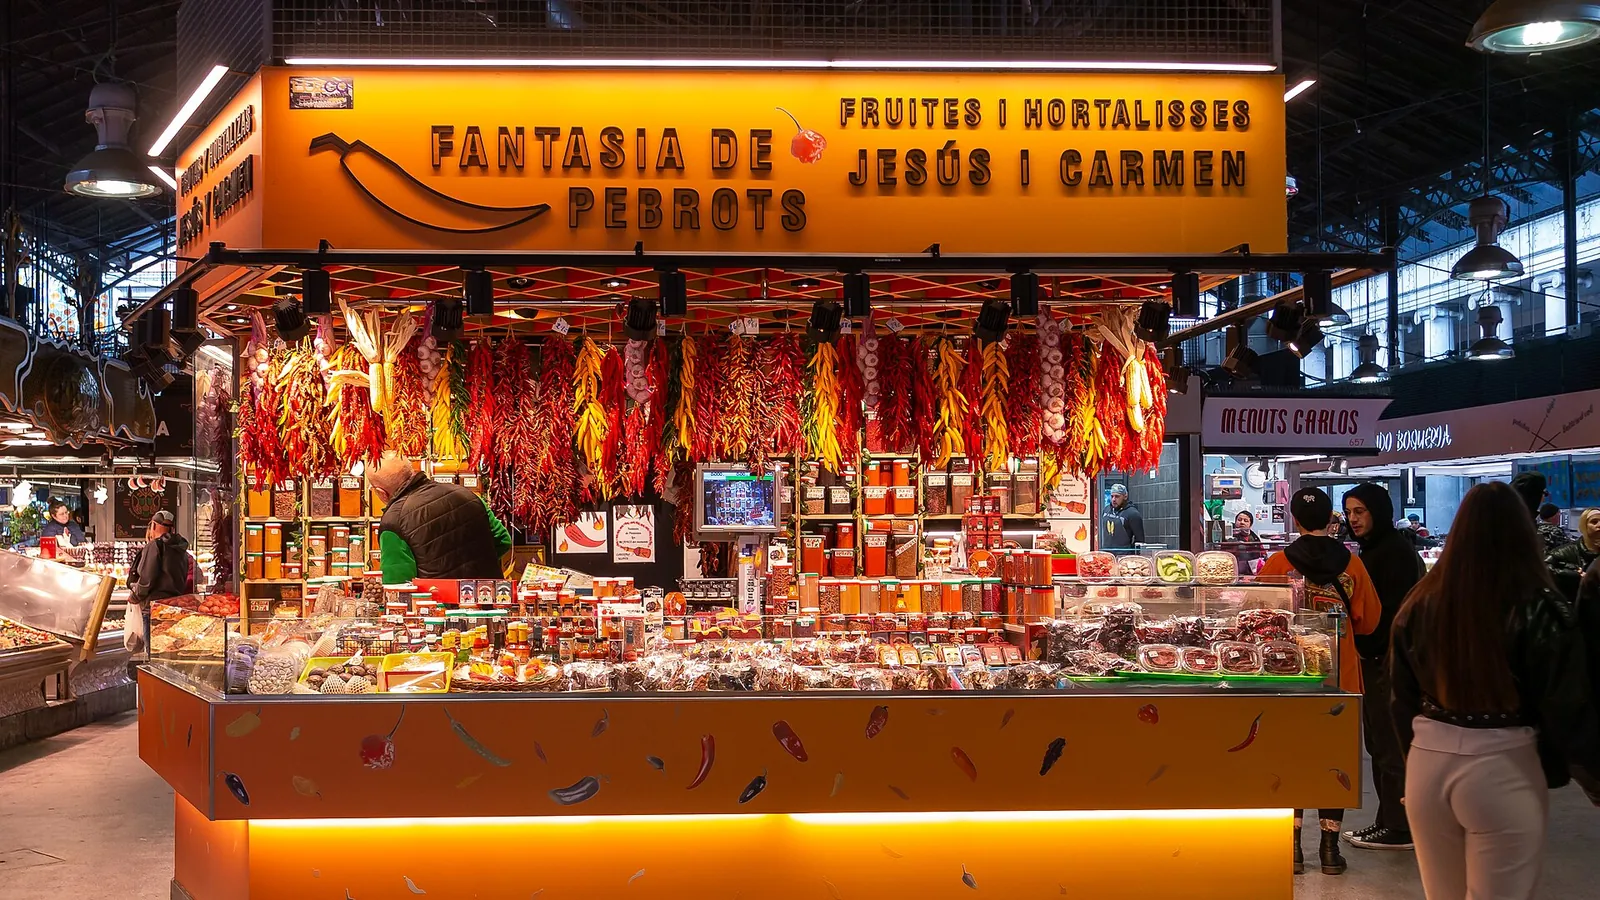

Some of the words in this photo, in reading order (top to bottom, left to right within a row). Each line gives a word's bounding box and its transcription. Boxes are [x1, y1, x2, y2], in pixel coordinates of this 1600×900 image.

[840, 97, 982, 127] FRUITES
[998, 98, 1006, 127] I
[1025, 98, 1251, 128] HORTALISSES
[431, 125, 686, 170] FANTASIA
[711, 128, 774, 171] DE
[848, 140, 991, 187] JESÚS
[1020, 149, 1030, 187] I
[1059, 149, 1246, 187] CARMEN
[212, 154, 253, 219] CARMEN
[568, 187, 807, 232] PEBROTS
[1220, 408, 1288, 435] MENUTS
[1292, 409, 1359, 435] CARLOS
[1396, 424, 1452, 452] BOQUERIA
[1349, 438, 1365, 447] 657
